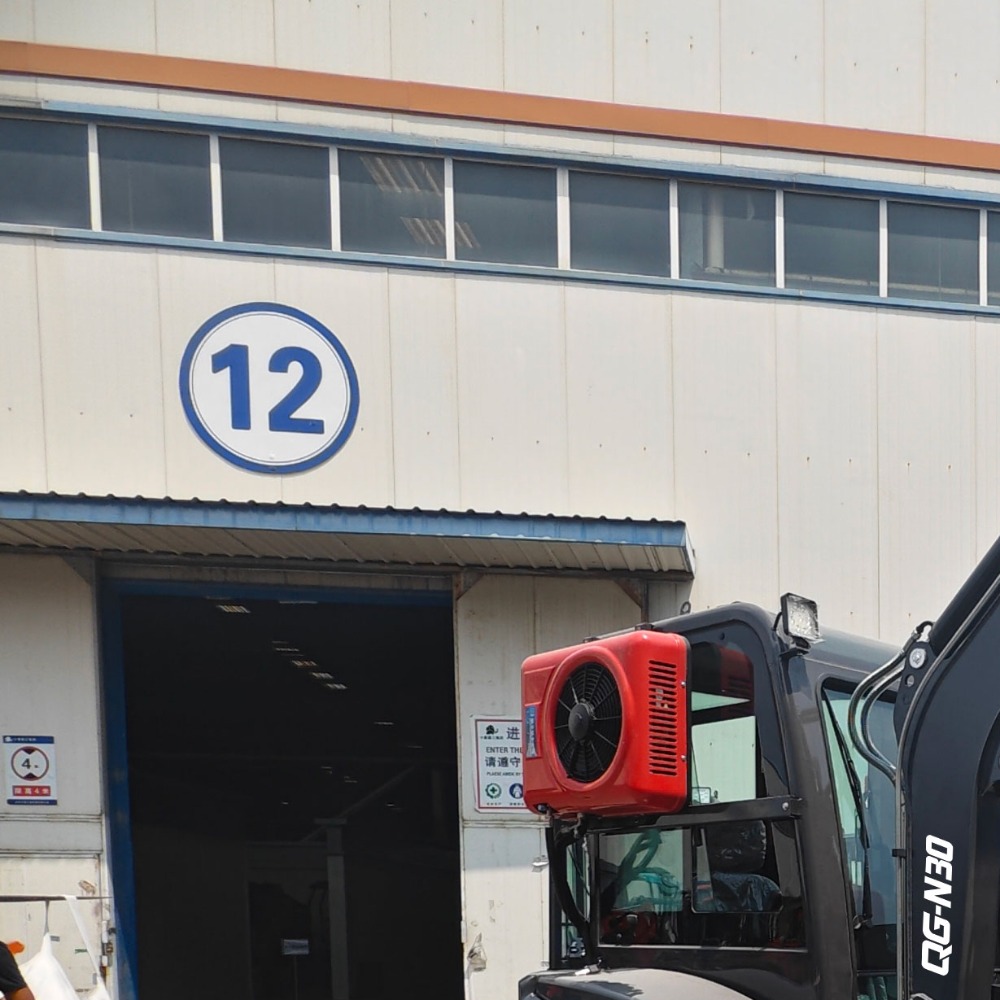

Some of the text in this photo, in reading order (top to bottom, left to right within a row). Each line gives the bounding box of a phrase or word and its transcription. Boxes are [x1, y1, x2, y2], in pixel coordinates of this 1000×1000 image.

[211, 343, 325, 435] 12
[485, 746, 509, 754] ENTER
[485, 756, 521, 768] 请遵守
[921, 834, 954, 977] QG-N30
